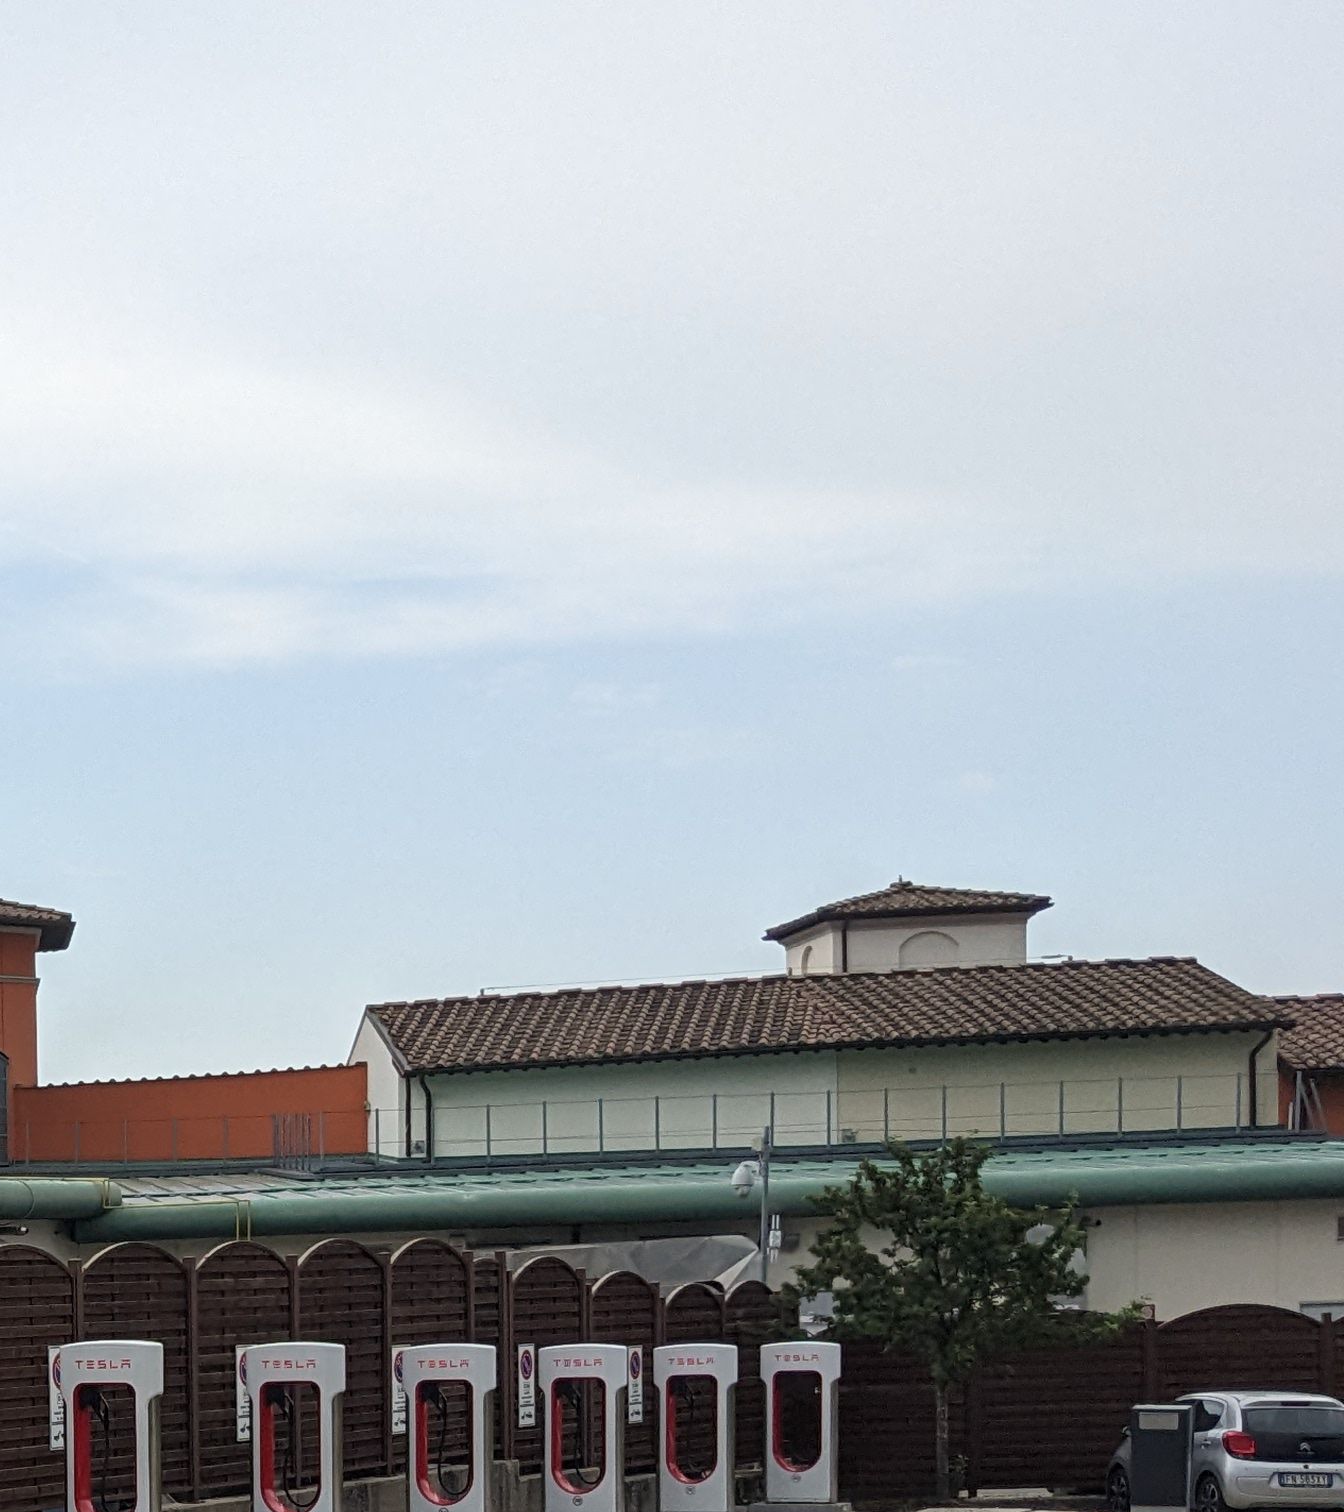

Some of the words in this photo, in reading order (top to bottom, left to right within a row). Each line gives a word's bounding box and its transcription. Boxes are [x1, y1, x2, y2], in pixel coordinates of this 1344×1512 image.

[553, 1358, 603, 1368] TESLA
[774, 1354, 819, 1362] TESLA
[74, 1358, 131, 1370] TESLA
[261, 1359, 316, 1369] TESLA
[417, 1359, 469, 1369] TESLA
